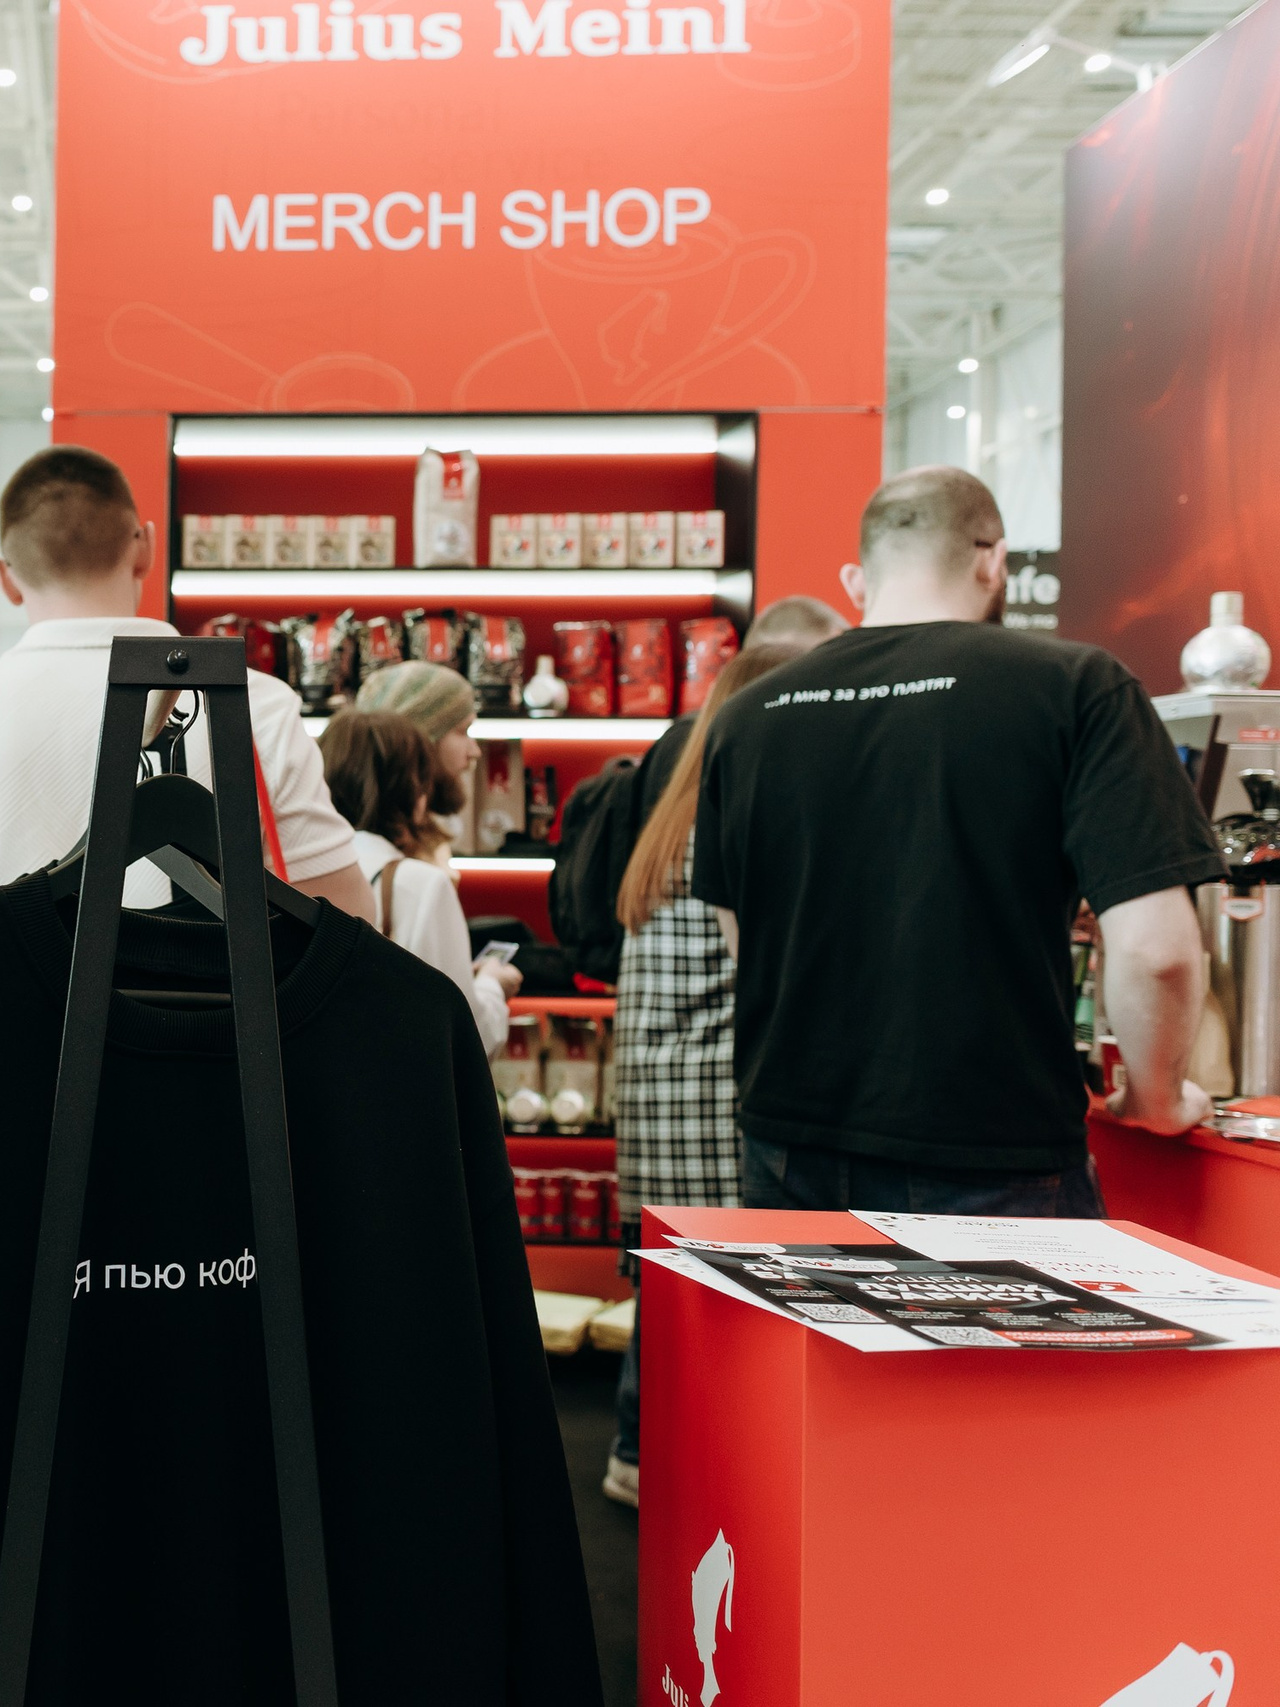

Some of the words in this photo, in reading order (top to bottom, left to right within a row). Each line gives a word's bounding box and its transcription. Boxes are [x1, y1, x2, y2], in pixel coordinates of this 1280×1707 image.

[179, 0, 463, 66] Julius
[492, 0, 752, 58] Meinl
[211, 191, 477, 252] MERCH
[499, 187, 713, 250] SHOP
[72, 1258, 91, 1300] Я
[104, 1263, 186, 1290] пью
[199, 1248, 257, 1289] коф
[854, 1282, 1053, 1293] ЛУЧШИХ
[871, 1275, 982, 1284] ИЩЕМ
[865, 1291, 1079, 1302] БАРИСТА
